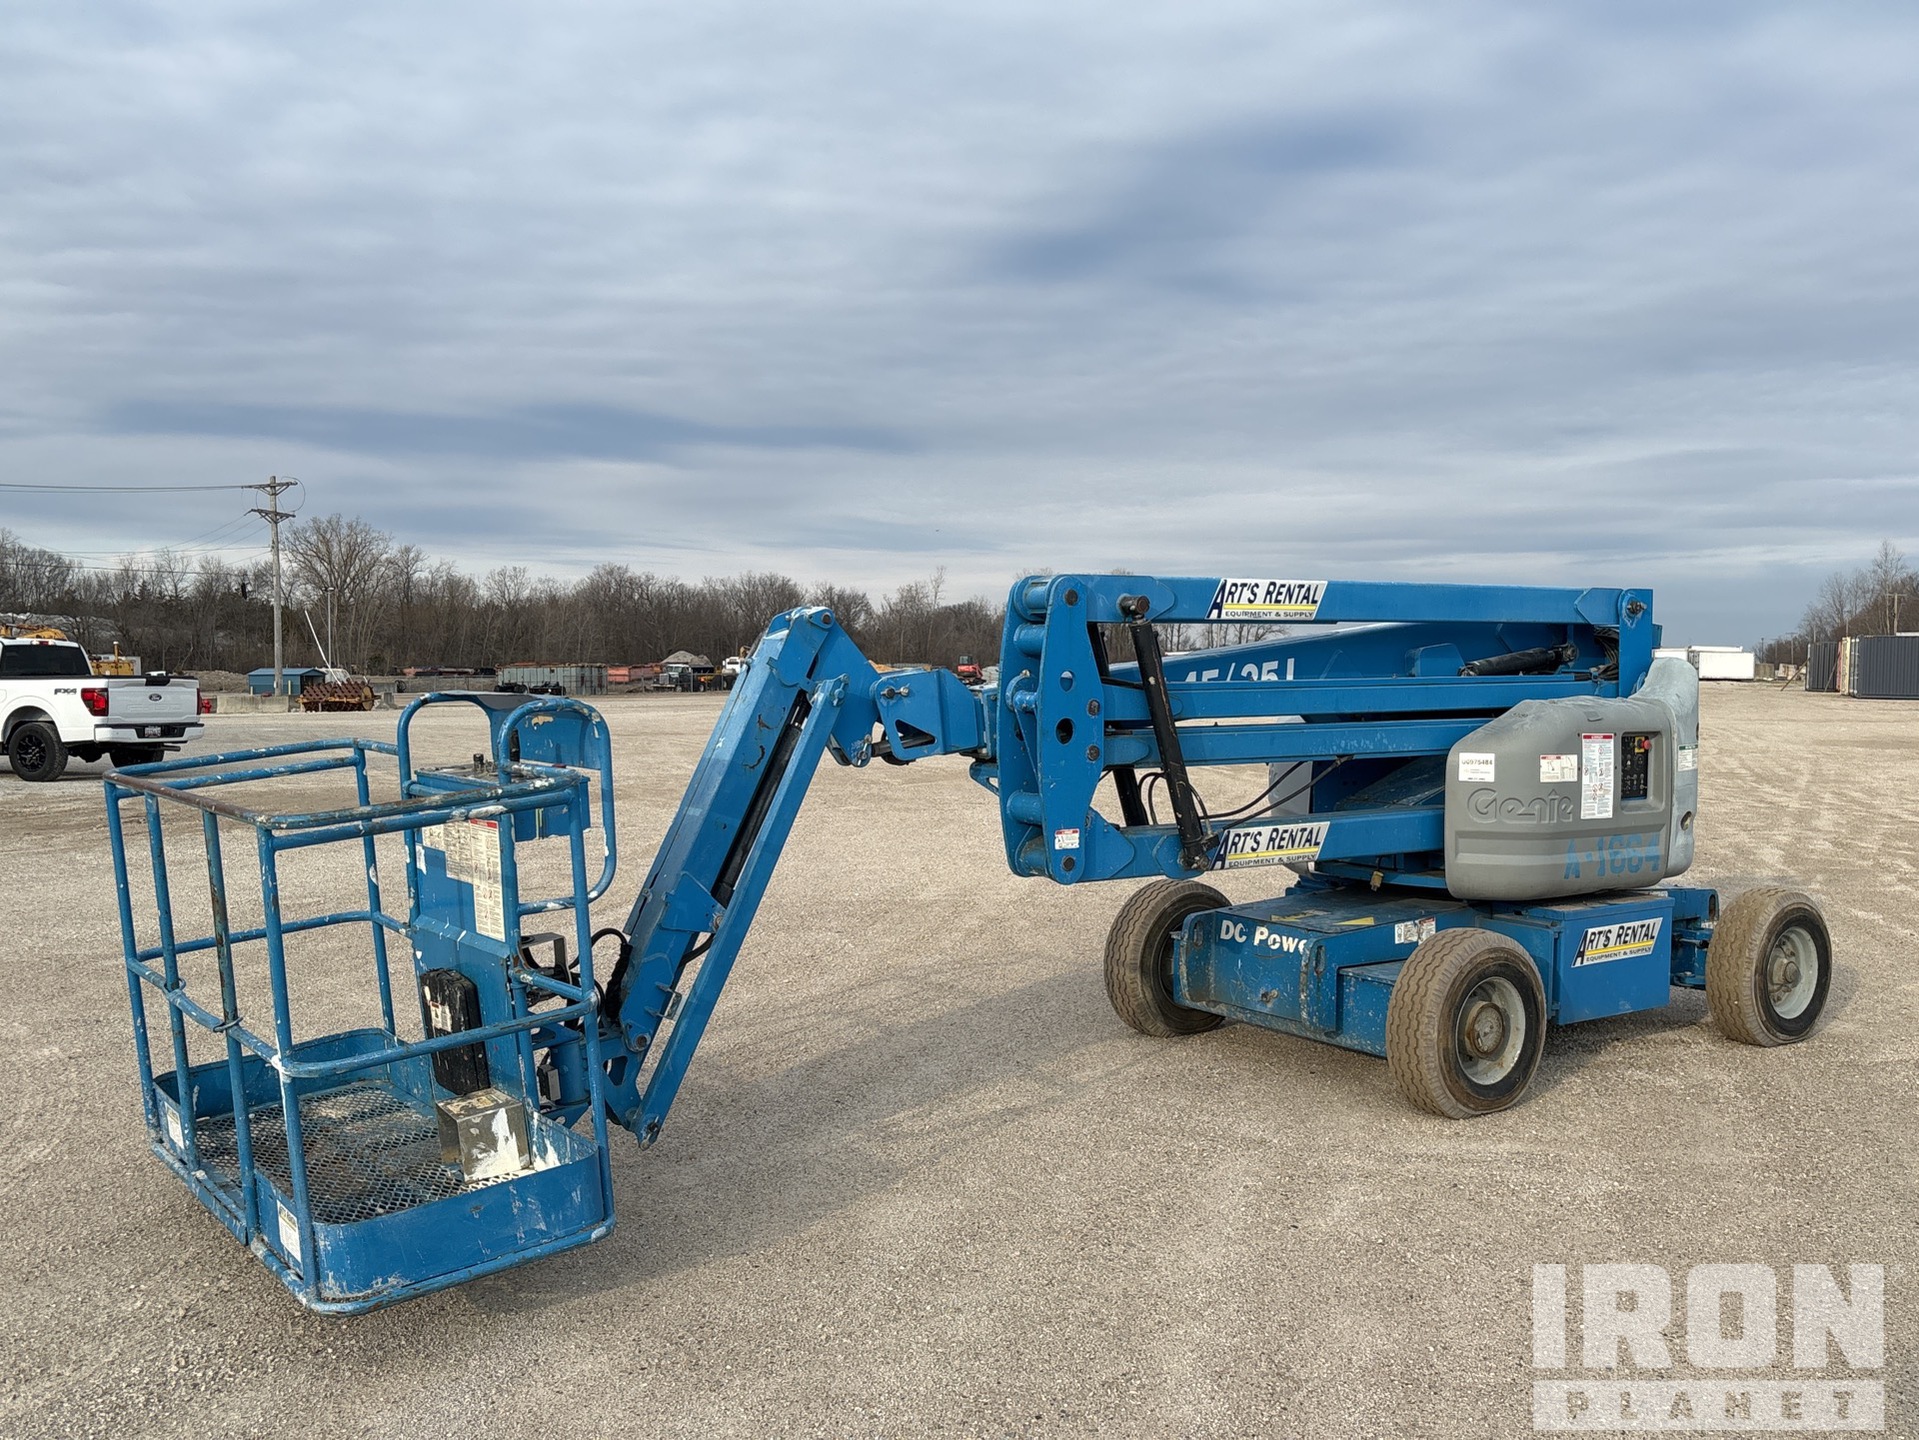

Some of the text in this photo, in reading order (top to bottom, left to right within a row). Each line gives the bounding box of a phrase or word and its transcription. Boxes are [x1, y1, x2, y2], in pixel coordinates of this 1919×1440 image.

[1206, 579, 1320, 619] ART'S RENTAL
[1467, 787, 1574, 824] Genie
[1209, 826, 1321, 870] ART'S RENTAL
[1228, 858, 1275, 867] EQUIPMENT
[1286, 853, 1316, 862] SUPPLY
[1220, 919, 1247, 943] DC
[1573, 922, 1656, 966] ART'S RENTAL
[1586, 951, 1622, 962] EQUIPMENT
[1629, 946, 1652, 955] SUPPLY
